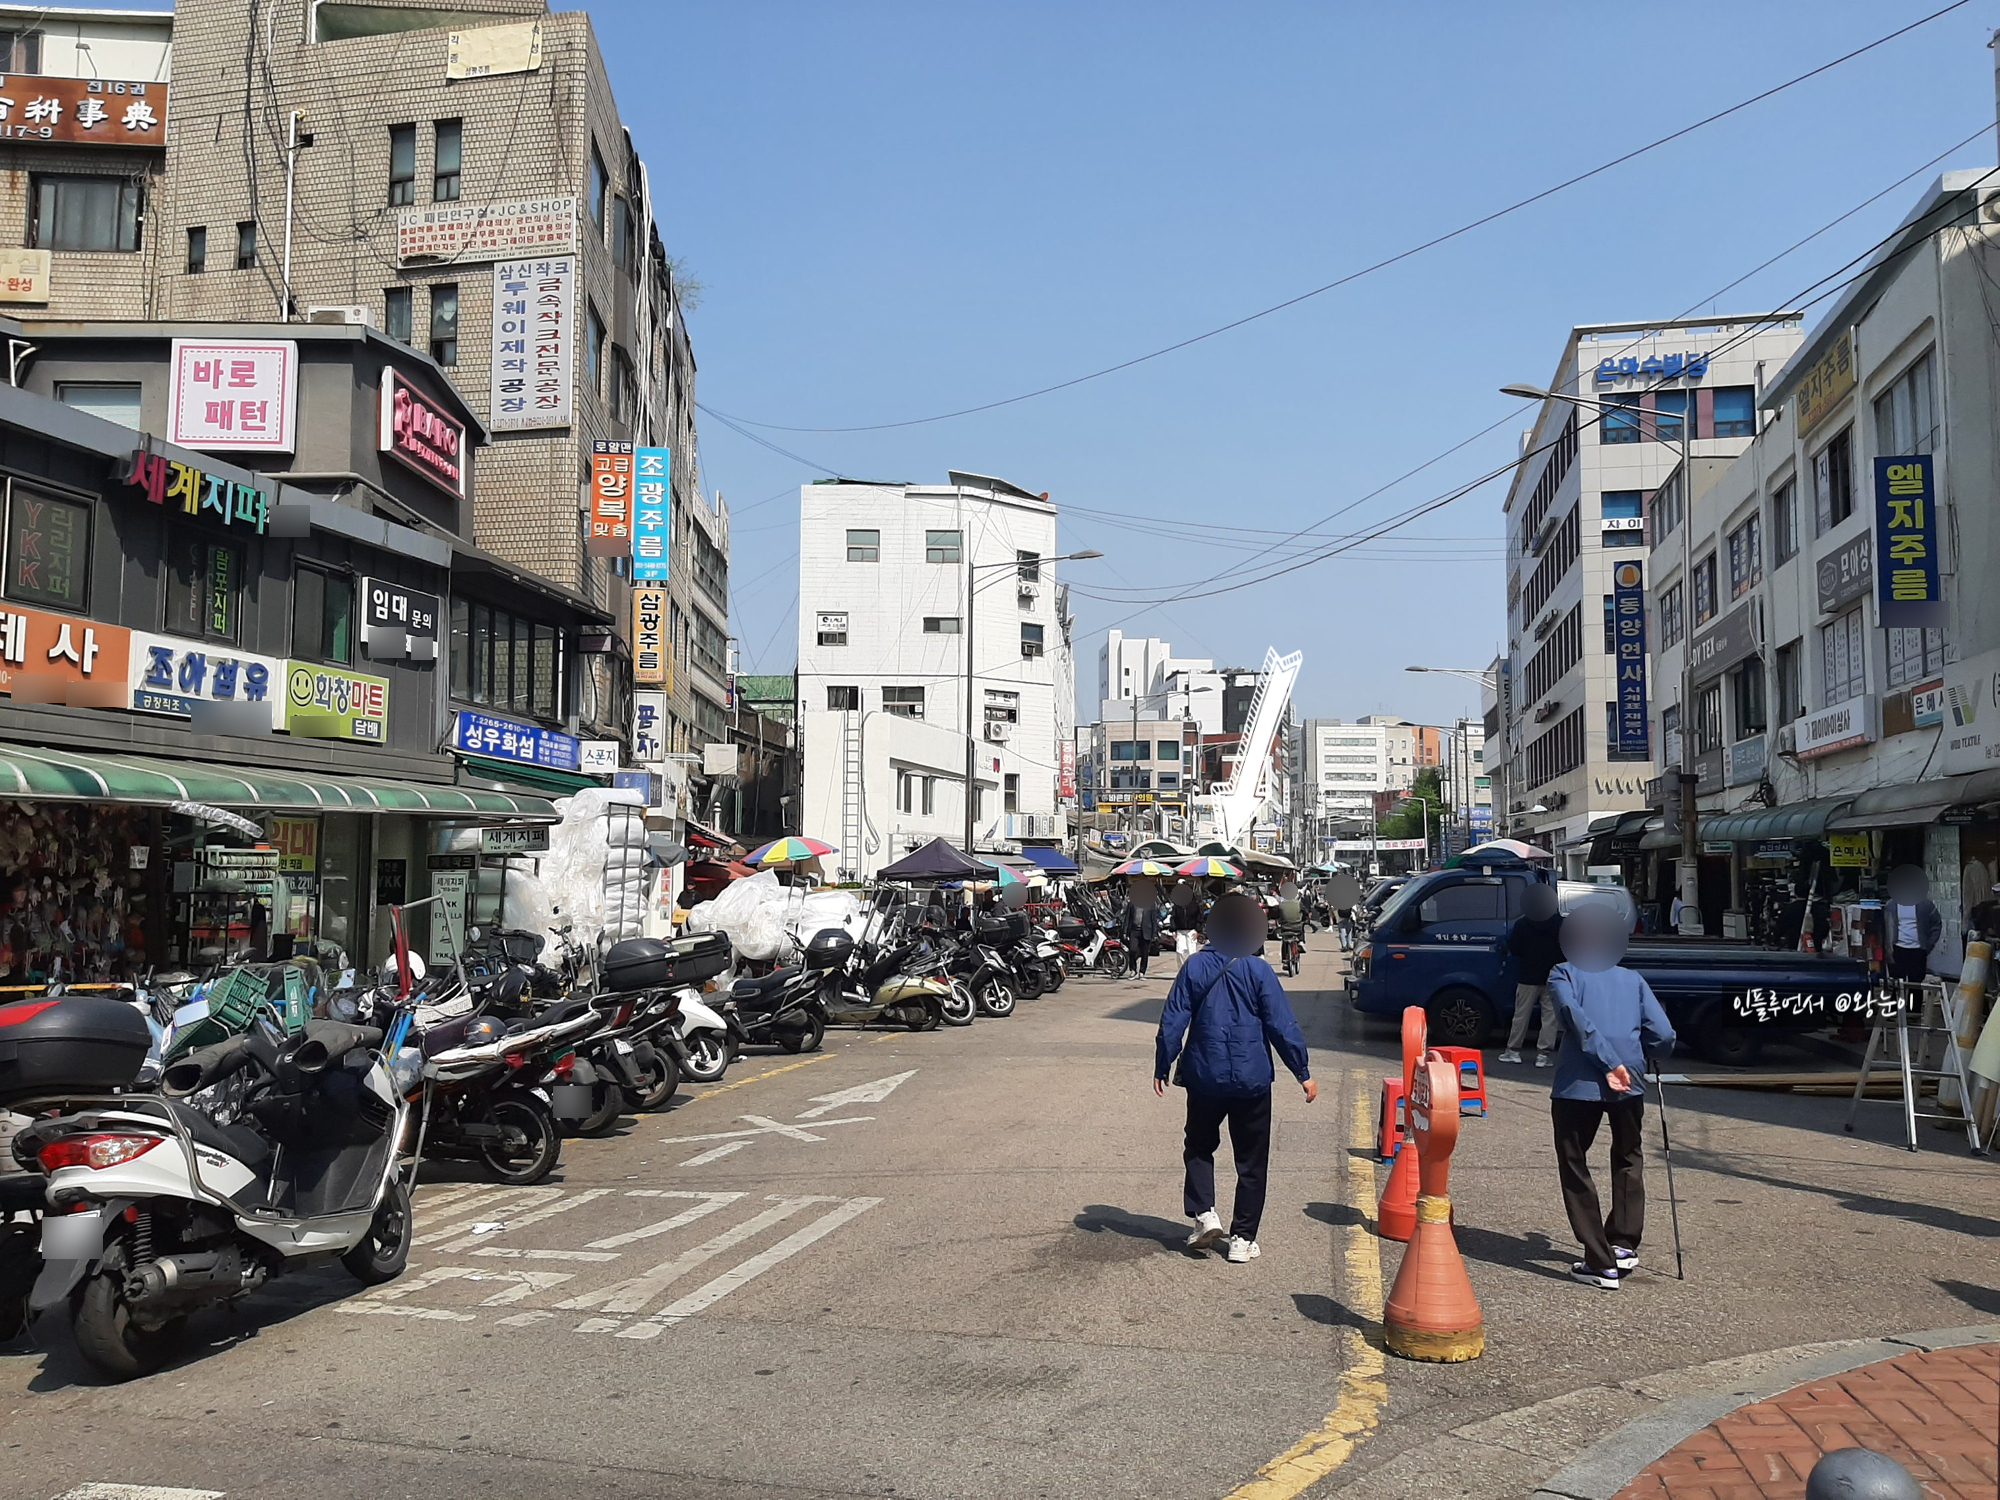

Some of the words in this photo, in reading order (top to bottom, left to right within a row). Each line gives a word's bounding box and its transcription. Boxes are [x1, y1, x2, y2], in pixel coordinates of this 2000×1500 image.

[401, 215, 418, 226] JC
[193, 358, 258, 390] 바로
[1798, 336, 1850, 417] 엘지주름
[204, 400, 268, 432] 패턴
[413, 403, 458, 456] BARO
[595, 456, 631, 473] 고급
[128, 449, 268, 534] 세계지퍼
[597, 474, 629, 521] 양복
[638, 455, 666, 559] 조광주름
[18, 499, 44, 591] YKK
[594, 522, 629, 538] 맞춤
[1886, 464, 1928, 600] 엘지주름
[644, 570, 659, 579] 3F
[372, 588, 408, 622] 임대
[411, 610, 433, 631] 문의
[638, 592, 663, 670] 삼광주름
[1619, 596, 1643, 683] 동양연사
[1702, 636, 1716, 659] TEX
[144, 646, 272, 701] 조아섬유
[314, 672, 384, 718] 화창마트
[355, 720, 379, 737] 담배
[465, 724, 535, 760] 성우화섬
[584, 749, 616, 766] 스폰지
[272, 821, 314, 857] 임대
[489, 829, 545, 843] 세계지퍼
